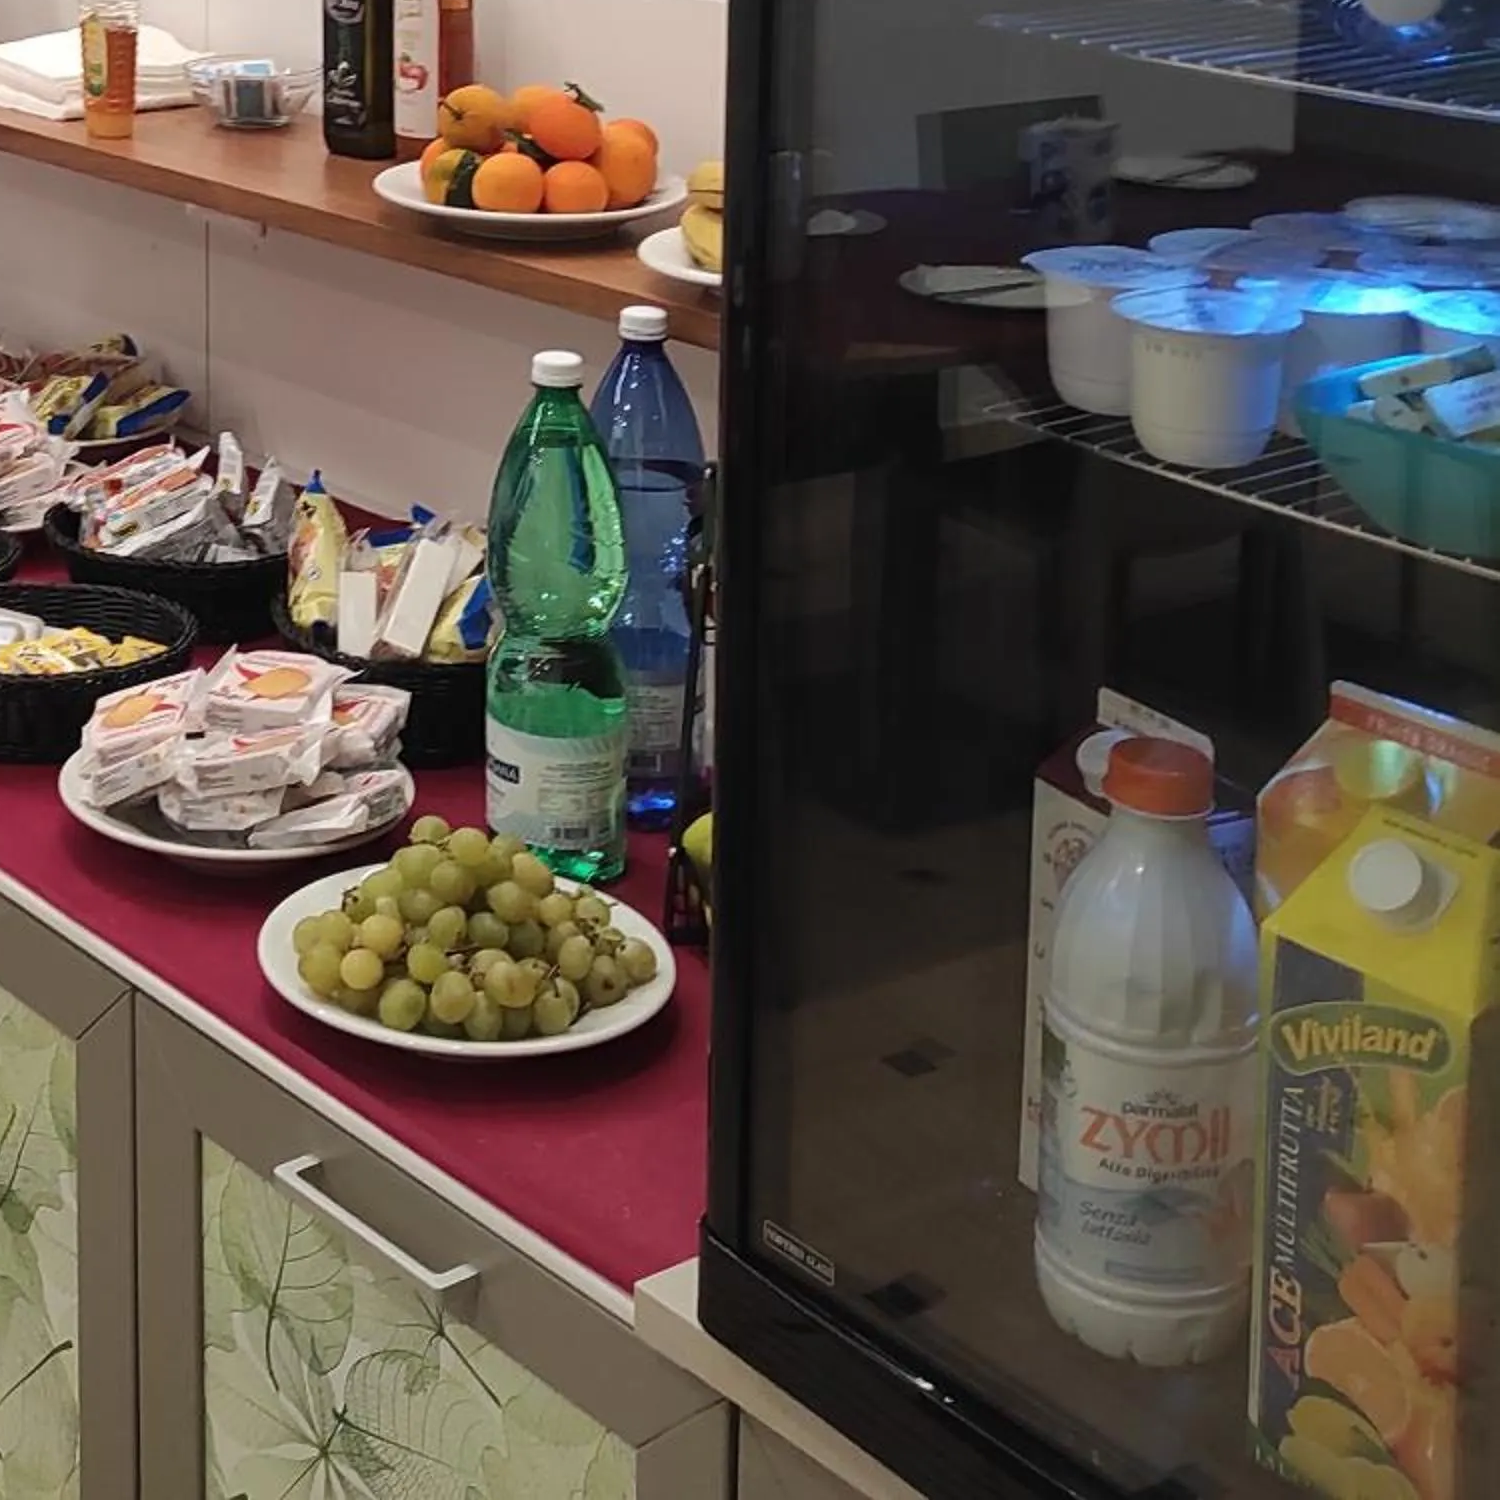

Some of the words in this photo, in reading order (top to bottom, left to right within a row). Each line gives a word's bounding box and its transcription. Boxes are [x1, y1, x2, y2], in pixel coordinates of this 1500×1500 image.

[1281, 1013, 1437, 1062] Viviland
[1275, 1086, 1305, 1271] MULTIFRUTTA
[1267, 1266, 1302, 1390] ACE
